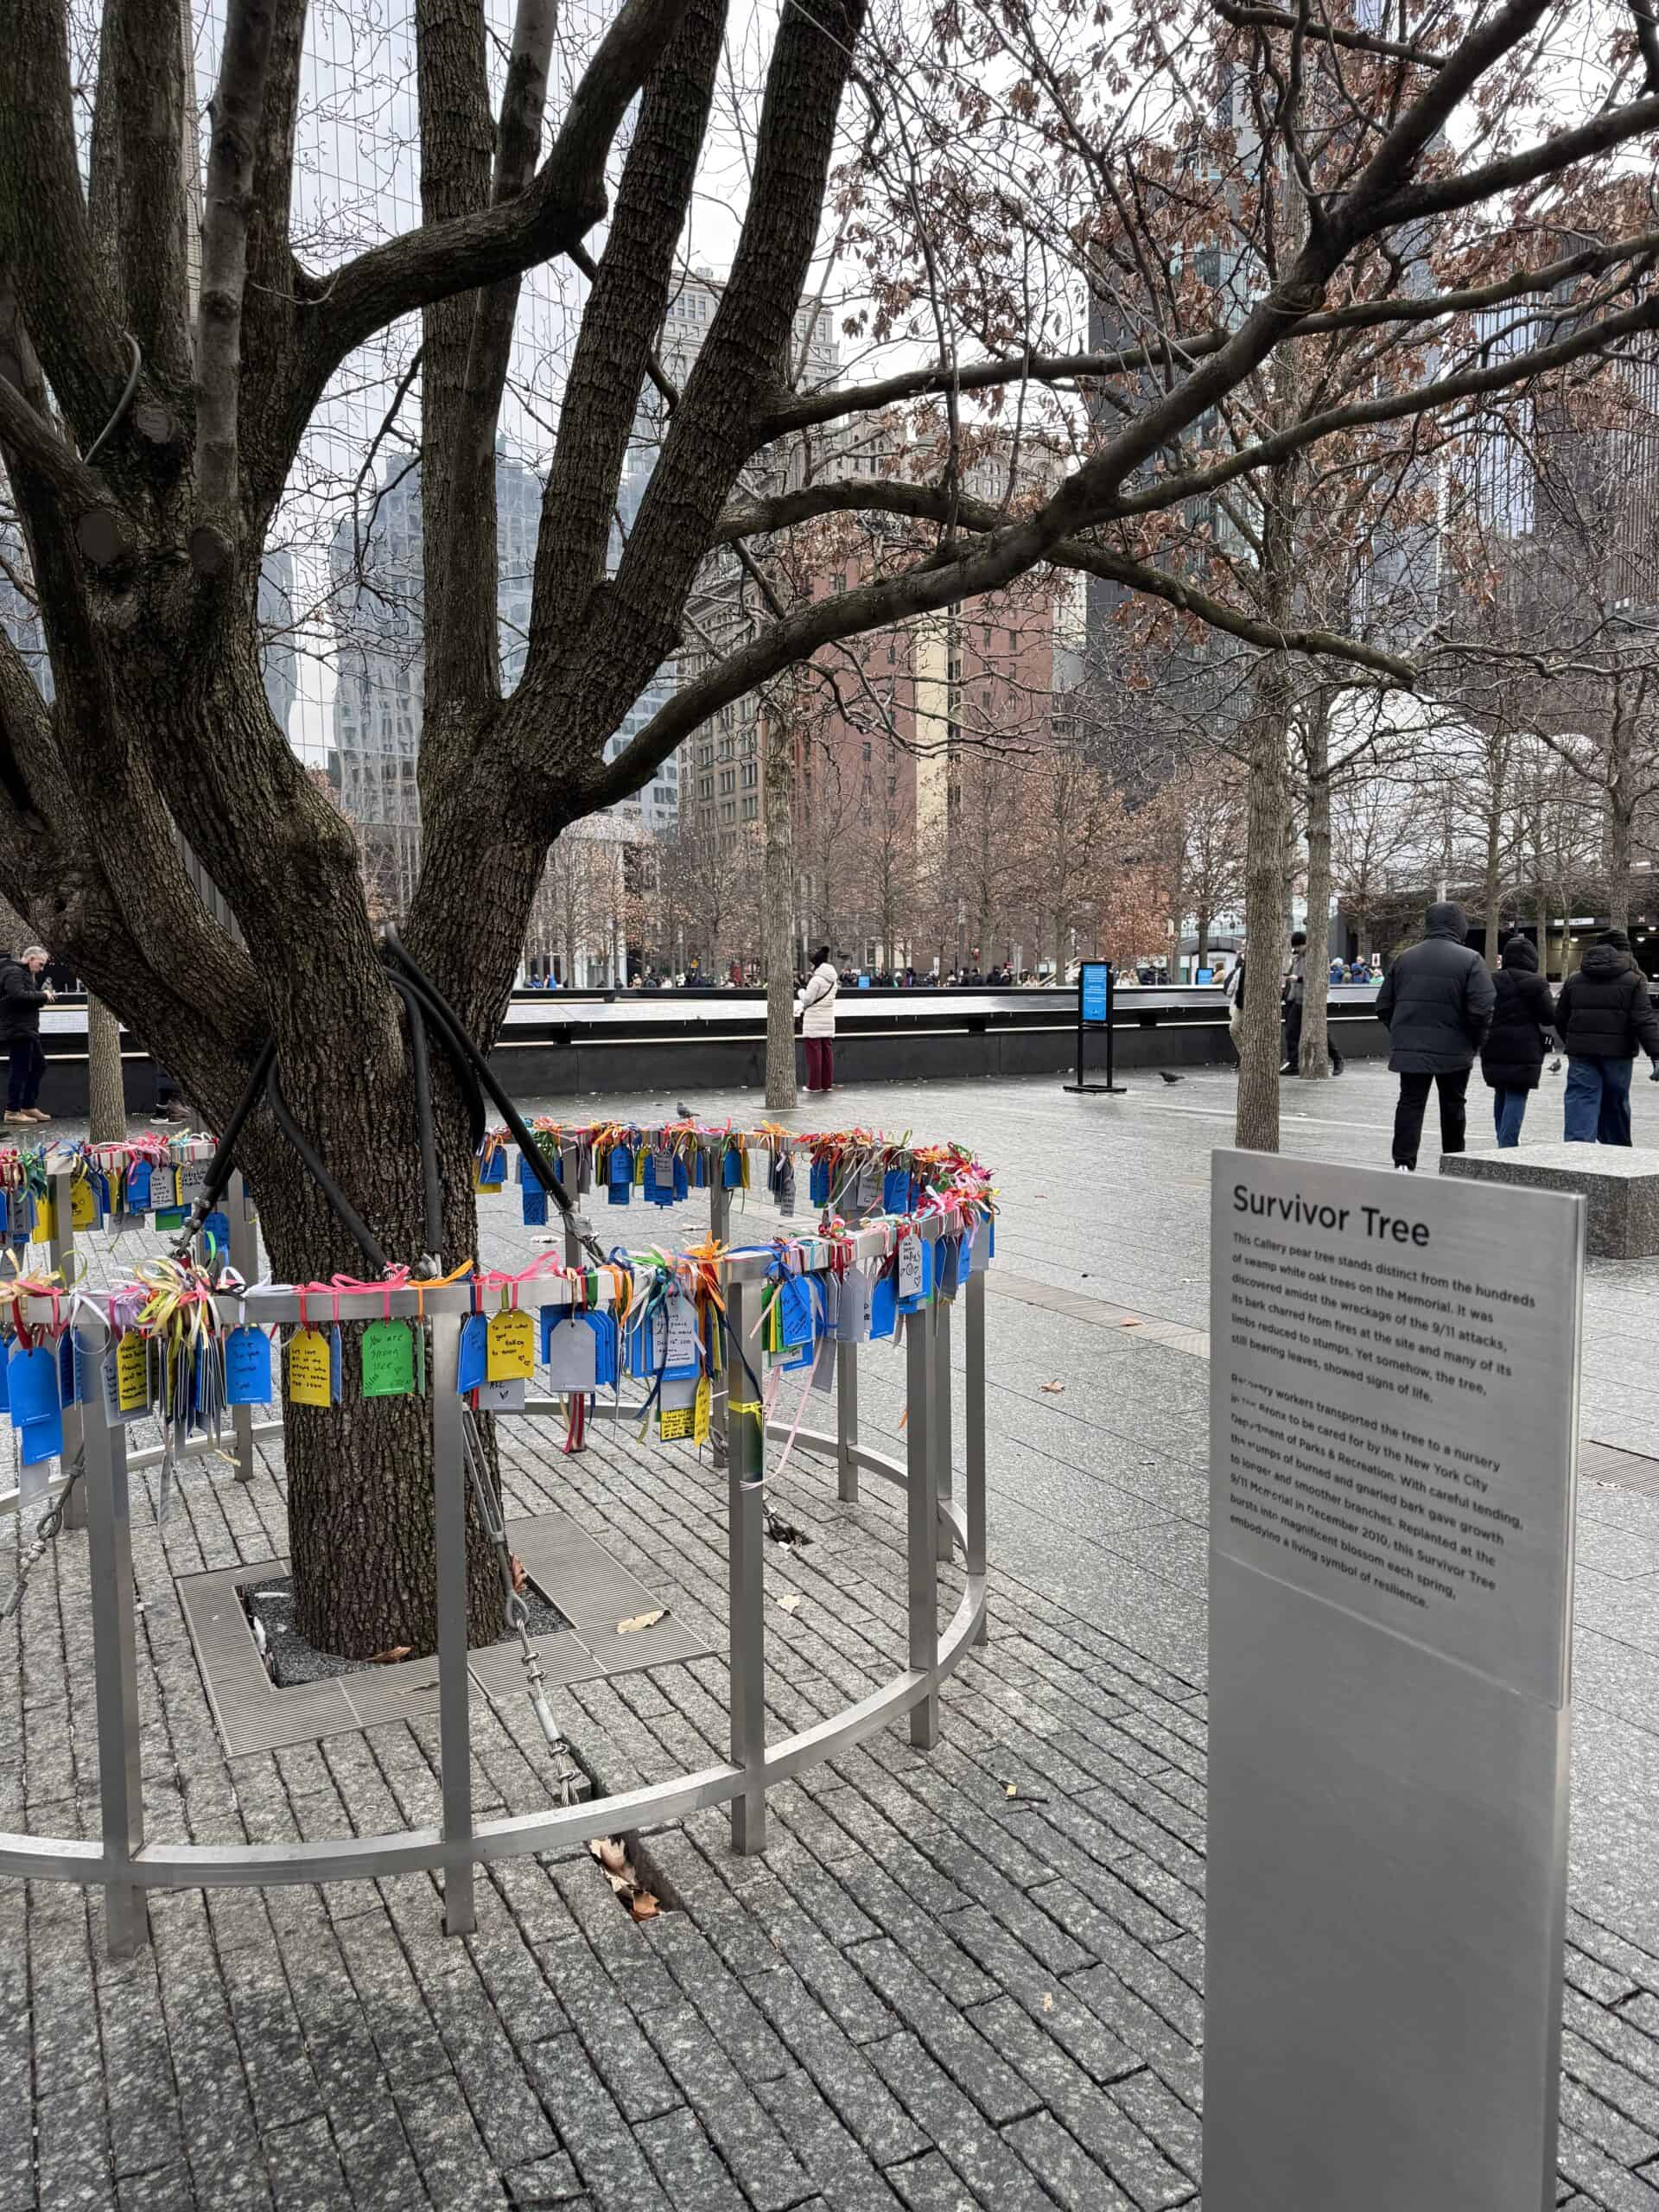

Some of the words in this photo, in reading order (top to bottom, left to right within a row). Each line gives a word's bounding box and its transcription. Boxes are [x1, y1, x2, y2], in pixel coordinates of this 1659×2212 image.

[1233, 1185, 1350, 1230] Survivor
[1361, 1206, 1430, 1247] Tree
[1231, 1253, 1243, 1263] of
[1244, 1257, 1277, 1273] swamp
[1279, 1264, 1306, 1280] white
[1307, 1272, 1328, 1284] oak
[1329, 1274, 1357, 1291] trees
[1358, 1283, 1373, 1294] on
[1376, 1285, 1395, 1300] the
[1396, 1290, 1453, 1314] Memorial.
[1457, 1304, 1466, 1318] It
[1470, 1308, 1494, 1324] was
[1233, 1231, 1252, 1245] This
[1253, 1236, 1287, 1255] Callery
[1288, 1246, 1313, 1259] pear
[1313, 1250, 1335, 1264] tree
[1338, 1255, 1373, 1273] stands
[1375, 1262, 1418, 1282] distinct
[1420, 1271, 1449, 1289] from
[1452, 1279, 1473, 1294] the
[1475, 1283, 1535, 1308] hundreds
[1231, 1273, 1282, 1295] discovered
[1284, 1287, 1318, 1304] amidst
[1320, 1294, 1338, 1309] the
[1340, 1301, 1392, 1323] wreckage
[1395, 1313, 1408, 1326] of
[1409, 1316, 1429, 1332] the
[1432, 1321, 1455, 1338] 9/11
[1458, 1330, 1508, 1353] attacks,
[1231, 1292, 1243, 1305] its
[1244, 1295, 1266, 1312] bark
[1268, 1304, 1306, 1322] charred
[1307, 1313, 1332, 1328] from
[1334, 1319, 1357, 1336] fires
[1359, 1328, 1371, 1340] at
[1373, 1330, 1392, 1345] the
[1395, 1338, 1415, 1351] site
[1418, 1344, 1441, 1358] and
[1444, 1351, 1477, 1370] many
[1479, 1359, 1494, 1372] of
[1496, 1363, 1512, 1376] its
[1231, 1313, 1255, 1328] limbs
[1257, 1322, 1298, 1341] reduced
[1299, 1332, 1311, 1344] to
[1313, 1338, 1353, 1357] stumps.
[1355, 1347, 1373, 1363] Yet
[1376, 1355, 1433, 1381] somehow,
[1435, 1370, 1456, 1386] the
[1458, 1376, 1487, 1397] tree,
[1230, 1334, 1248, 1346] still
[1249, 1338, 1286, 1360] bearing
[1287, 1349, 1321, 1370] leaves,
[1323, 1361, 1364, 1382] showed
[1365, 1375, 1395, 1392] signs
[1396, 1383, 1409, 1396] of
[1412, 1386, 1433, 1404] life.
[1275, 1389, 1314, 1410] workers
[1316, 1402, 1378, 1432] transported
[1380, 1423, 1399, 1439] the
[1401, 1430, 1425, 1447] tree
[1427, 1438, 1441, 1452] to
[1444, 1445, 1452, 1456] a
[1453, 1448, 1501, 1473] nursery
[1288, 1414, 1300, 1426] to
[1301, 1416, 1315, 1432] be
[1317, 1425, 1346, 1442] cared
[1349, 1433, 1364, 1448] for
[1366, 1439, 1381, 1456] by
[1382, 1446, 1402, 1462] the
[1404, 1452, 1430, 1471] New
[1433, 1463, 1459, 1483] York
[1463, 1473, 1489, 1494] City
[1230, 1433, 1246, 1446] the
[1282, 1454, 1294, 1466] of
[1295, 1458, 1332, 1480] burned
[1333, 1474, 1354, 1489] and
[1356, 1483, 1397, 1506] gnarled
[1400, 1497, 1425, 1515] bark
[1428, 1509, 1457, 1529] gave
[1459, 1522, 1504, 1546] growth
[1230, 1452, 1241, 1465] to
[1274, 1471, 1293, 1485] and
[1294, 1479, 1342, 1506] smoother
[1344, 1497, 1393, 1527] branches.
[1398, 1518, 1458, 1552] Replanted
[1459, 1545, 1472, 1558] at
[1476, 1549, 1496, 1567] the
[1287, 1434, 1297, 1446] of
[1299, 1437, 1325, 1457] Parks
[1328, 1448, 1335, 1460] &
[1338, 1451, 1398, 1483] Recreation.
[1400, 1474, 1427, 1494] With
[1429, 1487, 1469, 1509] careful
[1472, 1501, 1522, 1530] tending,
[1230, 1471, 1248, 1489] 9/11
[1294, 1499, 1305, 1512] in
[1306, 1503, 1359, 1535] December
[1361, 1527, 1390, 1549] 2010,
[1393, 1540, 1414, 1558] this
[1417, 1548, 1466, 1578] Survivor
[1469, 1570, 1496, 1591] Tree
[1230, 1492, 1259, 1513] bursts
[1280, 1516, 1338, 1548] magnificent
[1340, 1540, 1385, 1568] blossom
[1387, 1561, 1414, 1580] each
[1416, 1573, 1456, 1600] spring,
[1230, 1514, 1281, 1544] embodying
[1283, 1538, 1289, 1548] a
[1291, 1539, 1319, 1563] living
[1320, 1554, 1357, 1577] symbol
[1359, 1572, 1371, 1584] of
[1373, 1578, 1429, 1609] resilience.
